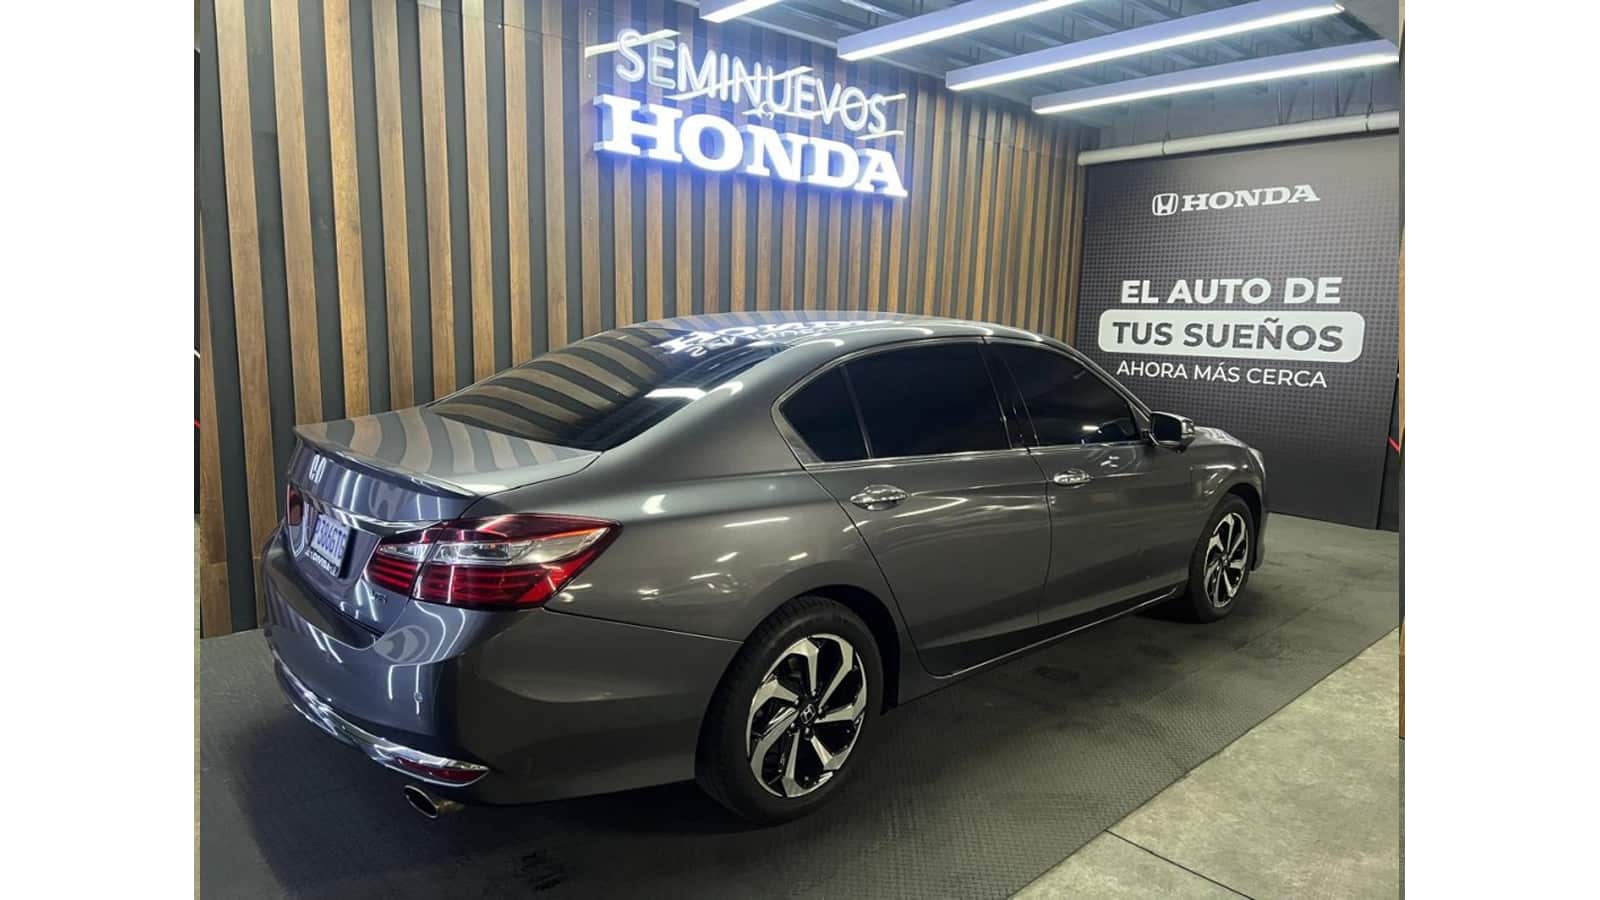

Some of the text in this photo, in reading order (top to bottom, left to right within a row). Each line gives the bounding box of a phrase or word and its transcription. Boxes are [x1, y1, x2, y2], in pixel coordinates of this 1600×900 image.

[616, 28, 886, 134] SEMINUEVOS
[594, 94, 907, 197] HONDA
[1181, 184, 1320, 212] HONDA
[1121, 277, 1343, 304] EL AUTO DE
[1113, 317, 1343, 352] TUS SUEÑOS
[1117, 360, 1327, 388] AHORA MÁS CERCA
